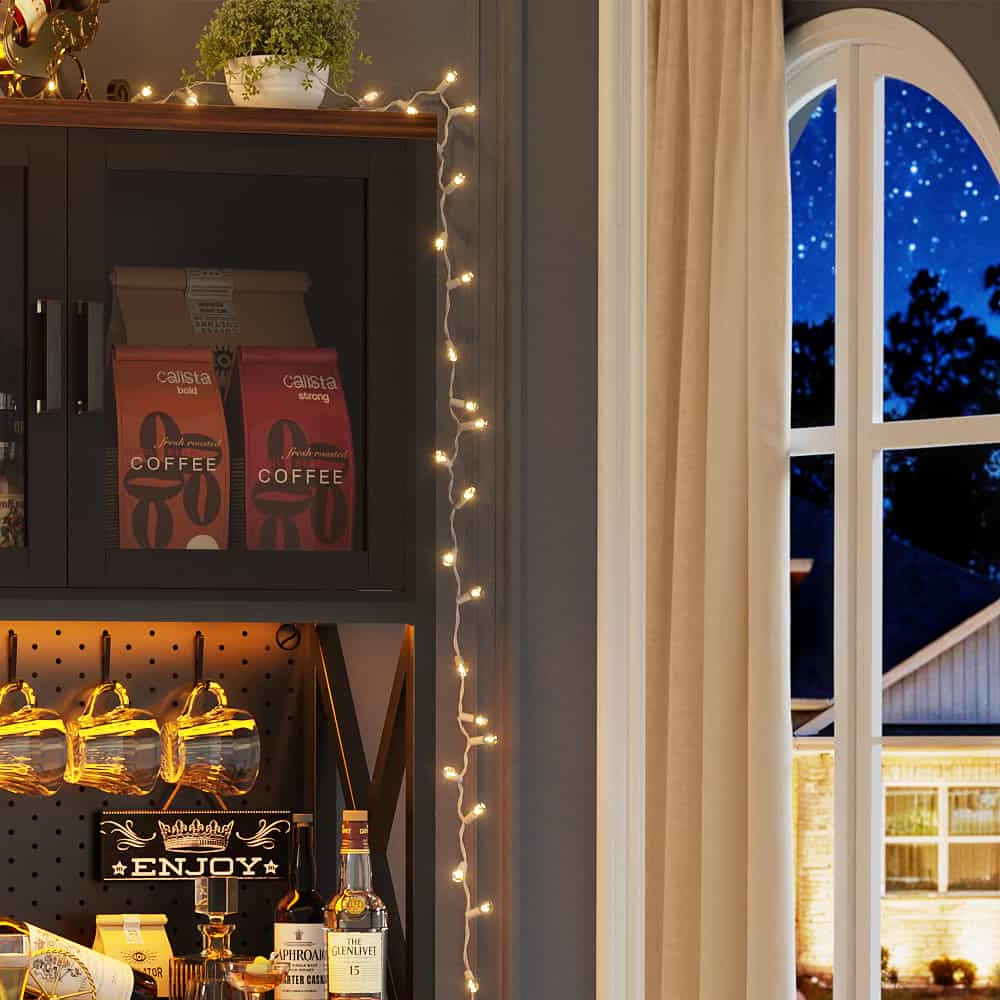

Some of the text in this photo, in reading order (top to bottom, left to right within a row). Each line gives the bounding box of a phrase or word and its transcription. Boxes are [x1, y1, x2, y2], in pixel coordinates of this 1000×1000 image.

[177, 385, 198, 395] bold
[298, 391, 330, 404] strong
[158, 435, 185, 449] fresh
[287, 446, 312, 459] fresh
[130, 457, 217, 472] COFFEE
[258, 468, 344, 485] COFFEE
[131, 857, 262, 876] ENJOY
[278, 949, 324, 962] APHROAI
[350, 966, 360, 975] 15
